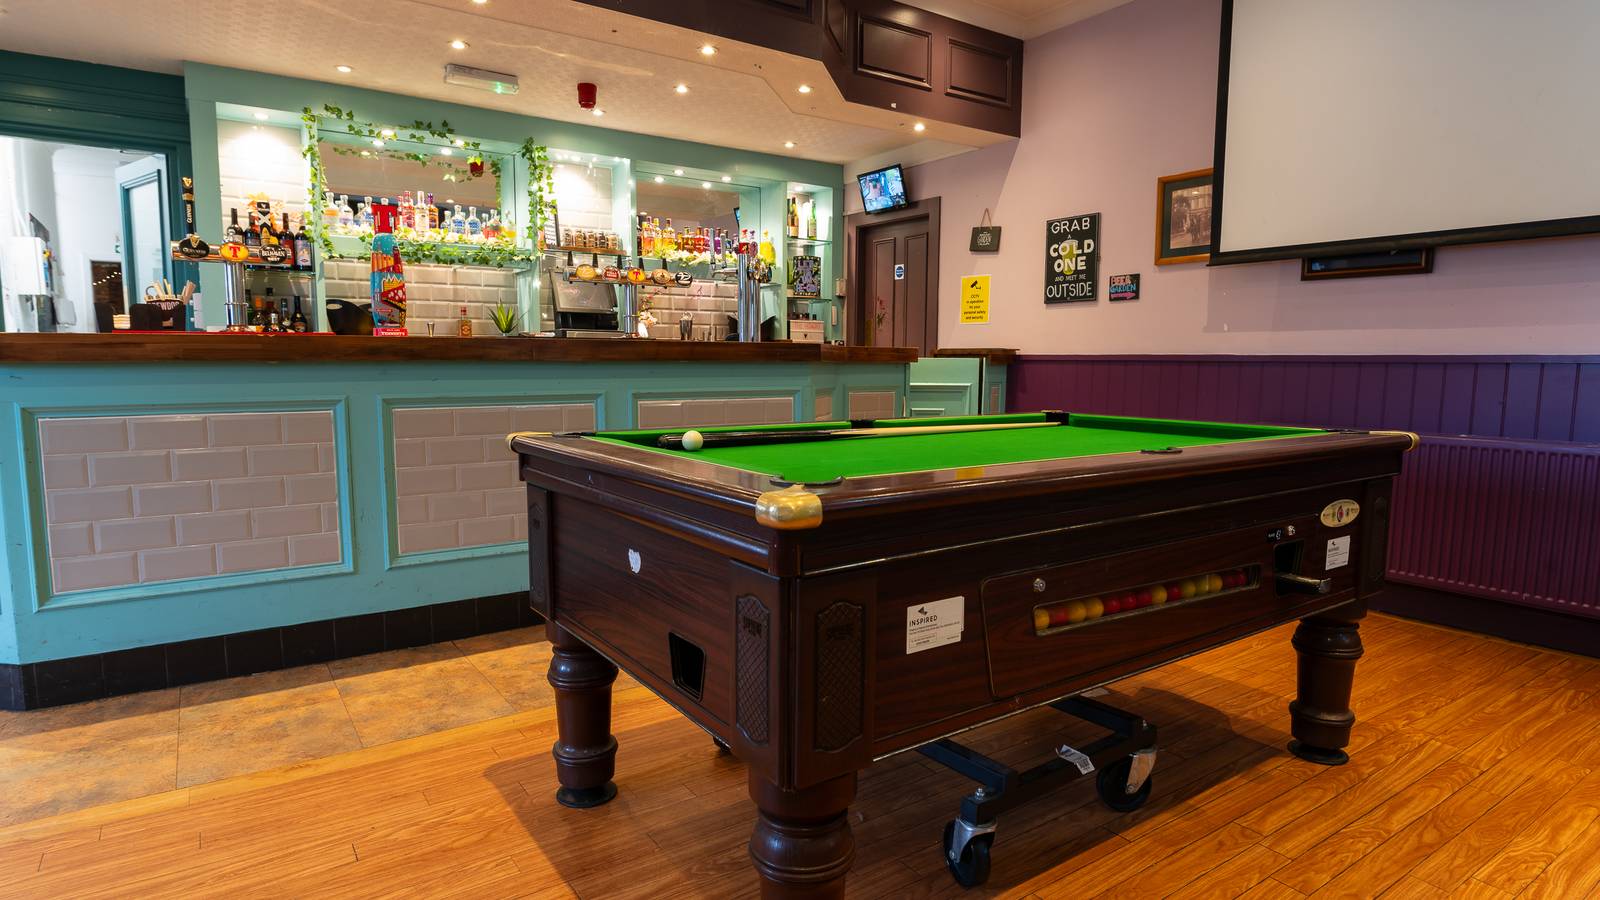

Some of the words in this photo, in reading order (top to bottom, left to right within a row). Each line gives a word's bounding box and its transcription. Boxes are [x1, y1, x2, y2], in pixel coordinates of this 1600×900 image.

[1051, 217, 1090, 234] GRAB
[1049, 239, 1095, 257] COLD
[1054, 256, 1087, 273] ONE
[1110, 283, 1136, 293] GARDEN
[1111, 276, 1131, 285] BEER
[1046, 281, 1093, 298] OUTSIDE
[909, 615, 938, 627] INSPIRED
